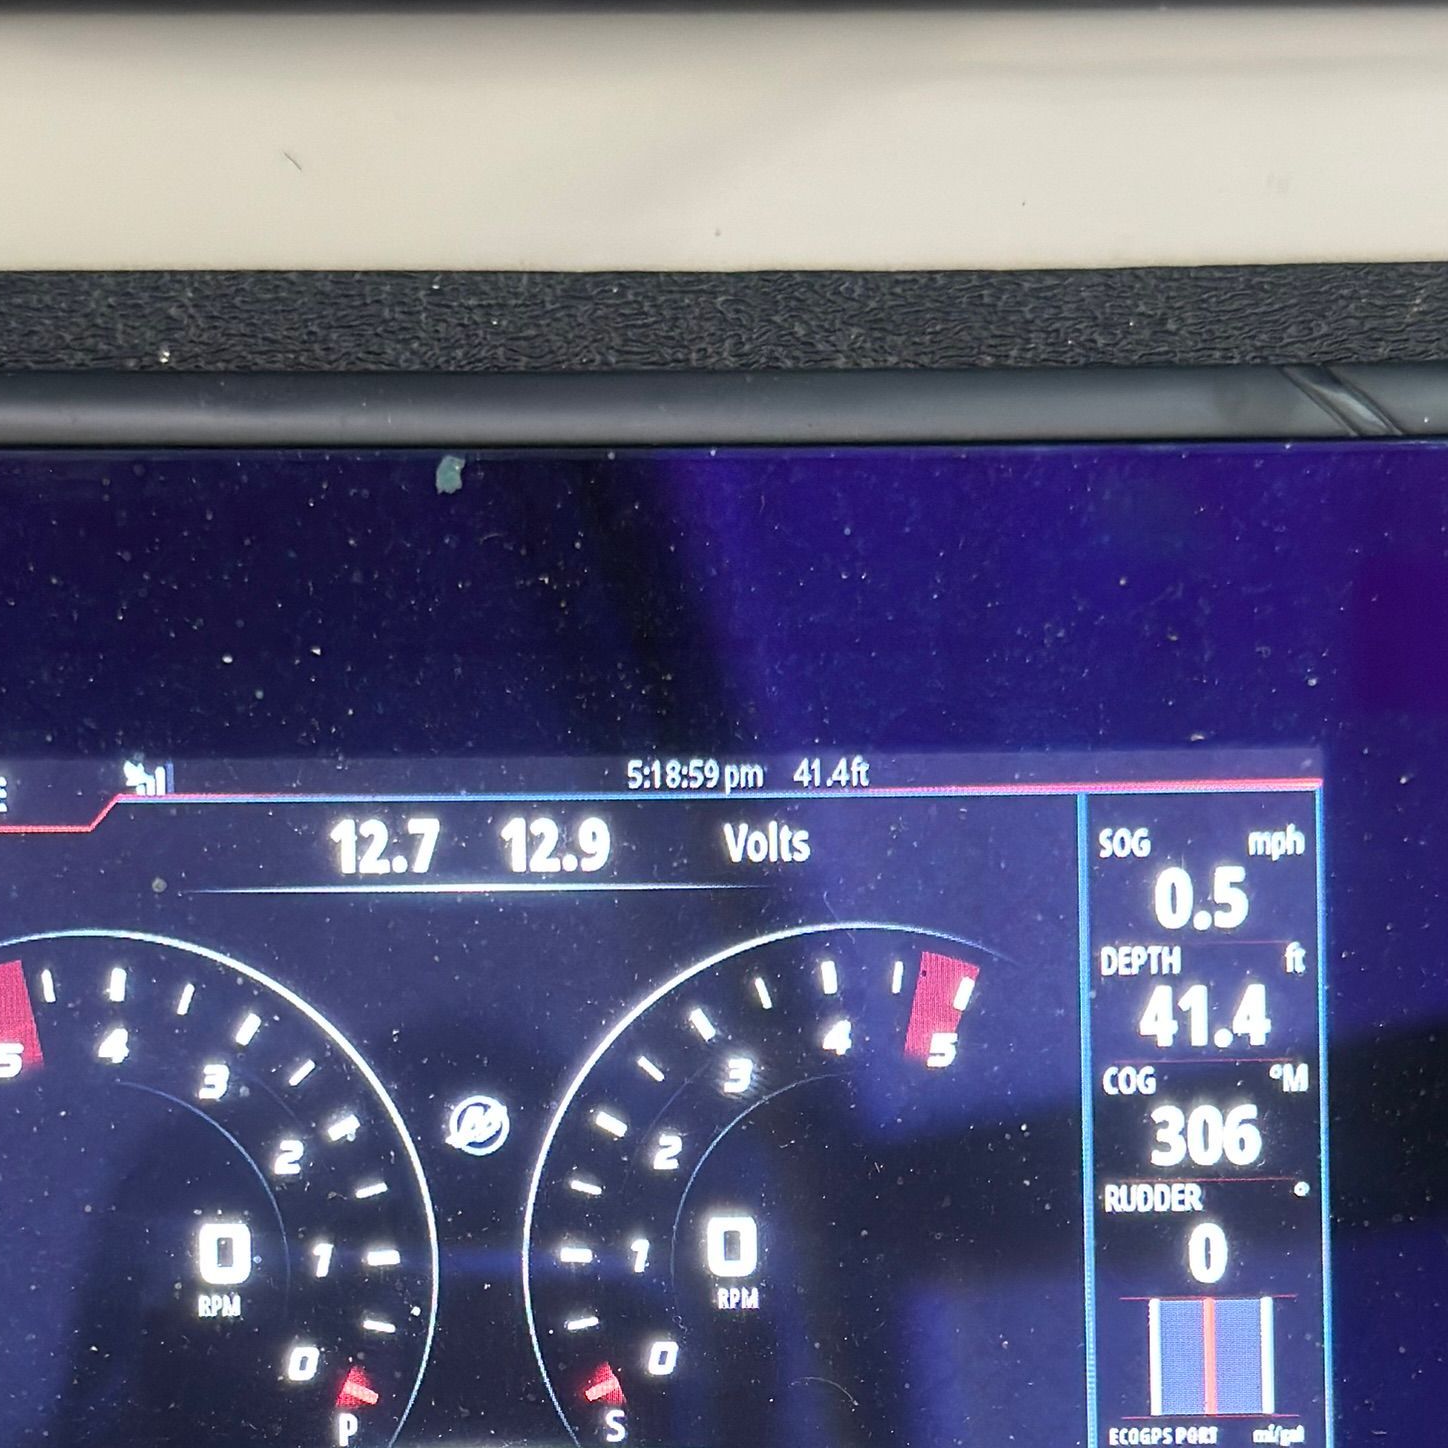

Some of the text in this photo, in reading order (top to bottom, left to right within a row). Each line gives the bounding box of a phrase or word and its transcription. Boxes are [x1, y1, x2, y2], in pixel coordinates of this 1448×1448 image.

[628, 759, 763, 794] 5:18:59 pm
[794, 756, 869, 786] 41.4ft
[329, 817, 810, 875] 12.7 12.9 Volts
[1099, 823, 1305, 861] SOG mph
[1152, 864, 1248, 930] 0.5
[1101, 942, 1306, 975] DEPTH ft
[1139, 983, 1271, 1047] 41.4
[98, 1028, 129, 1063] 4
[822, 1019, 851, 1055] 4
[926, 1033, 958, 1068] 5
[199, 1064, 229, 1101] 3
[722, 1058, 753, 1093] 3
[1103, 1066, 1156, 1094] COG
[652, 1132, 682, 1169] 2
[1151, 1104, 1262, 1166] 306
[273, 1140, 304, 1175] 2
[1105, 1183, 1203, 1212] RUDDER
[198, 1223, 251, 1285] 0
[312, 1241, 333, 1277] 1
[631, 1238, 649, 1272] 1
[706, 1215, 758, 1277] 0
[1188, 1222, 1228, 1283] 0
[198, 1294, 240, 1317] RPM
[717, 1286, 759, 1309] RPM
[286, 1345, 319, 1381] 0
[647, 1341, 679, 1375] 0
[338, 1413, 357, 1446] P
[605, 1409, 625, 1442] S
[1109, 1427, 1173, 1445] ECOGPS
[1175, 1426, 1218, 1444] PORT
